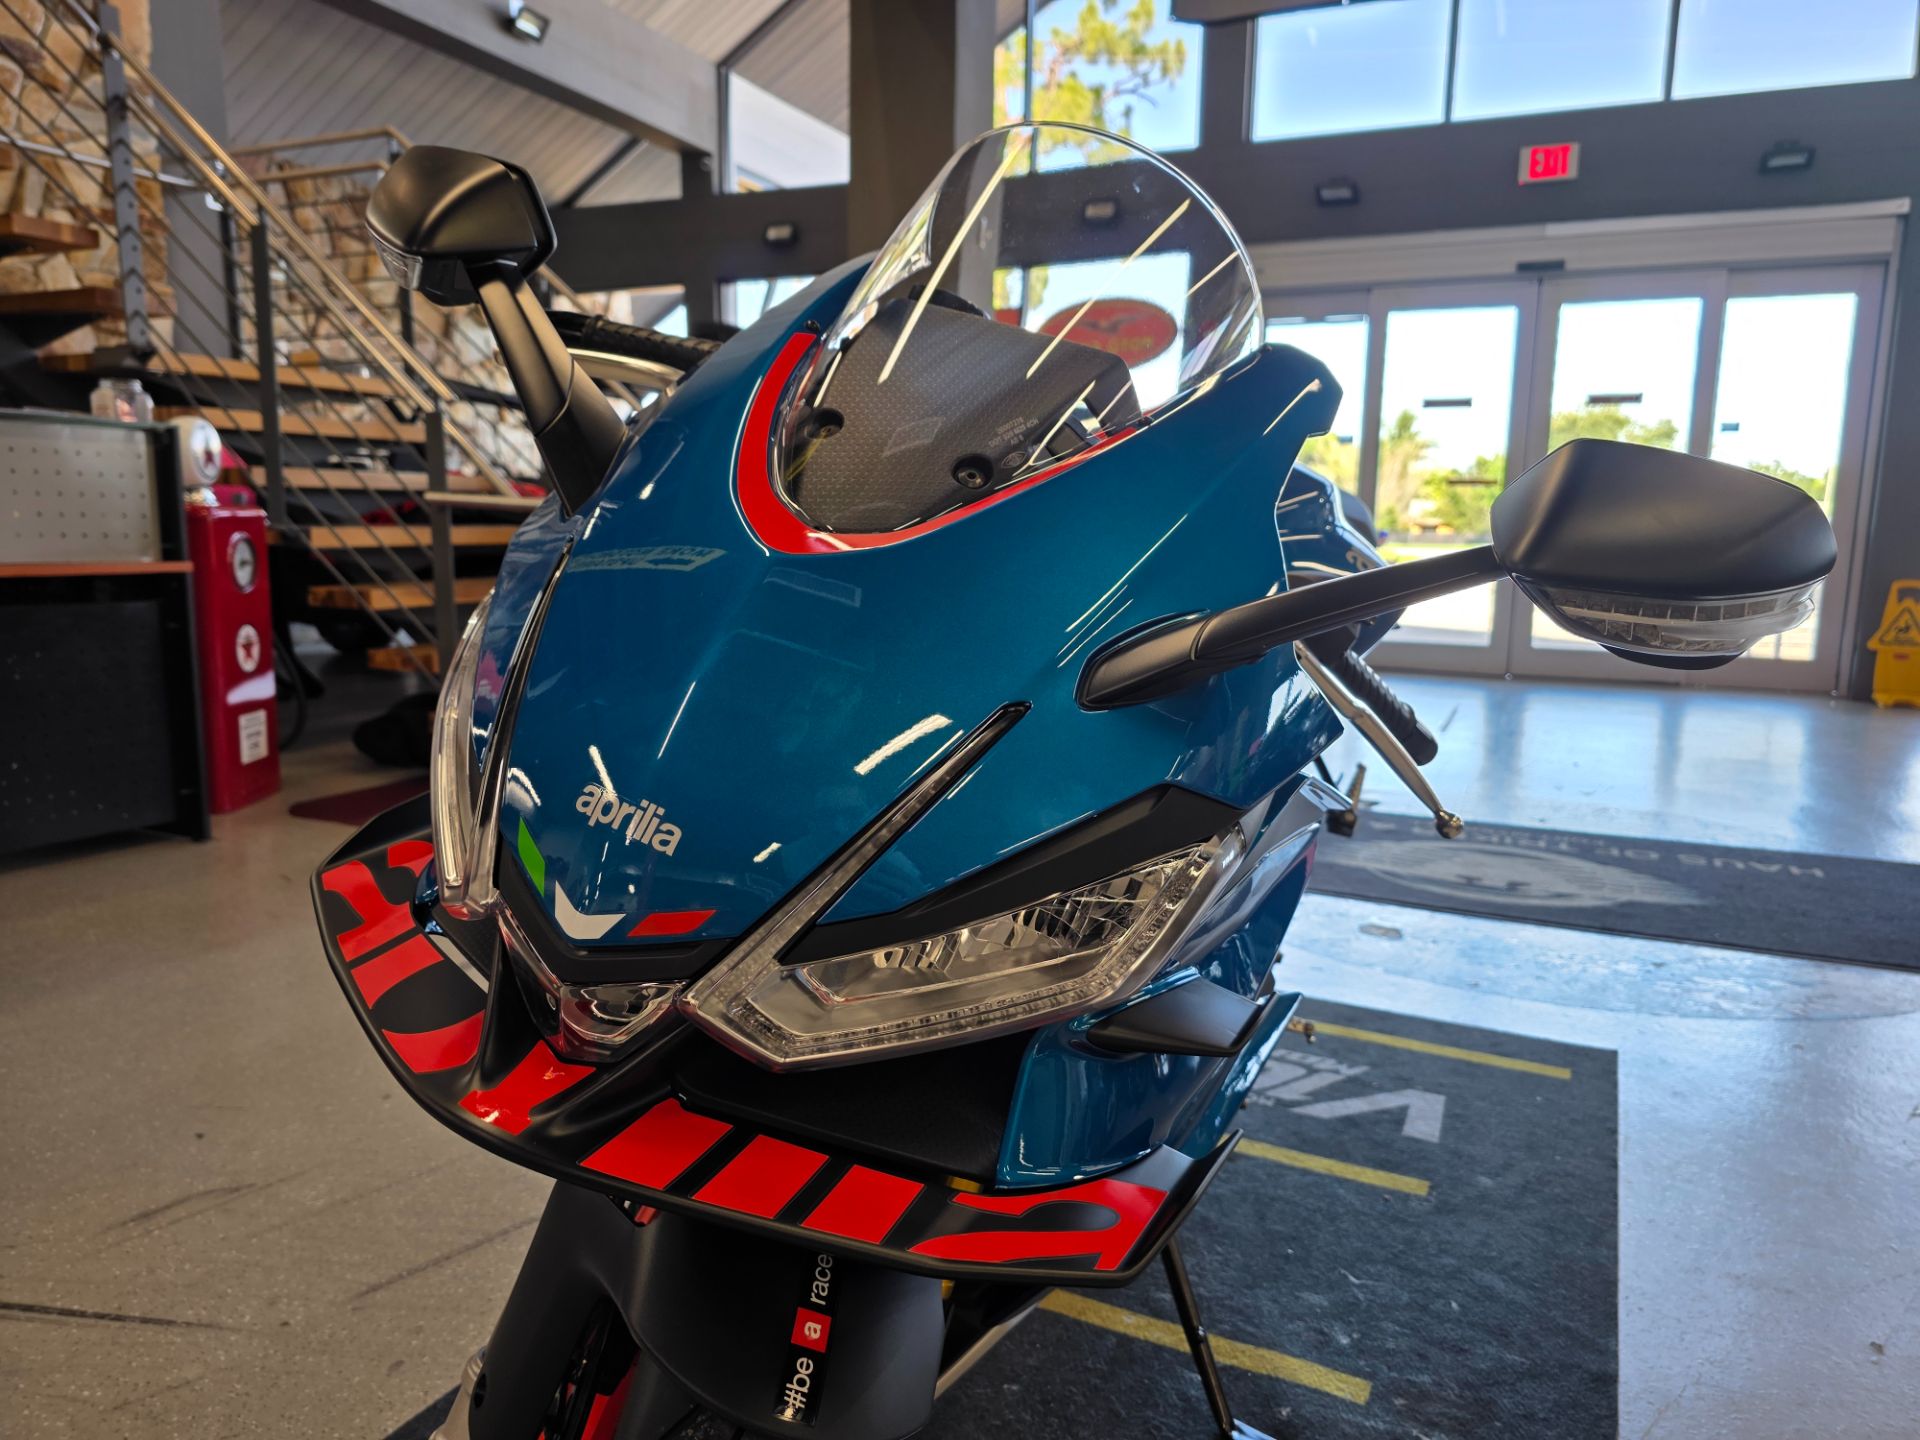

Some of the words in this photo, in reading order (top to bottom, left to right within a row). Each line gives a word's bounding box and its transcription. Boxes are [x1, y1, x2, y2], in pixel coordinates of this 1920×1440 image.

[1530, 144, 1571, 179] EXIT
[576, 784, 682, 857] aprilia
[810, 1254, 833, 1306] race
[804, 1321, 822, 1340] a
[783, 1357, 814, 1409] #be
